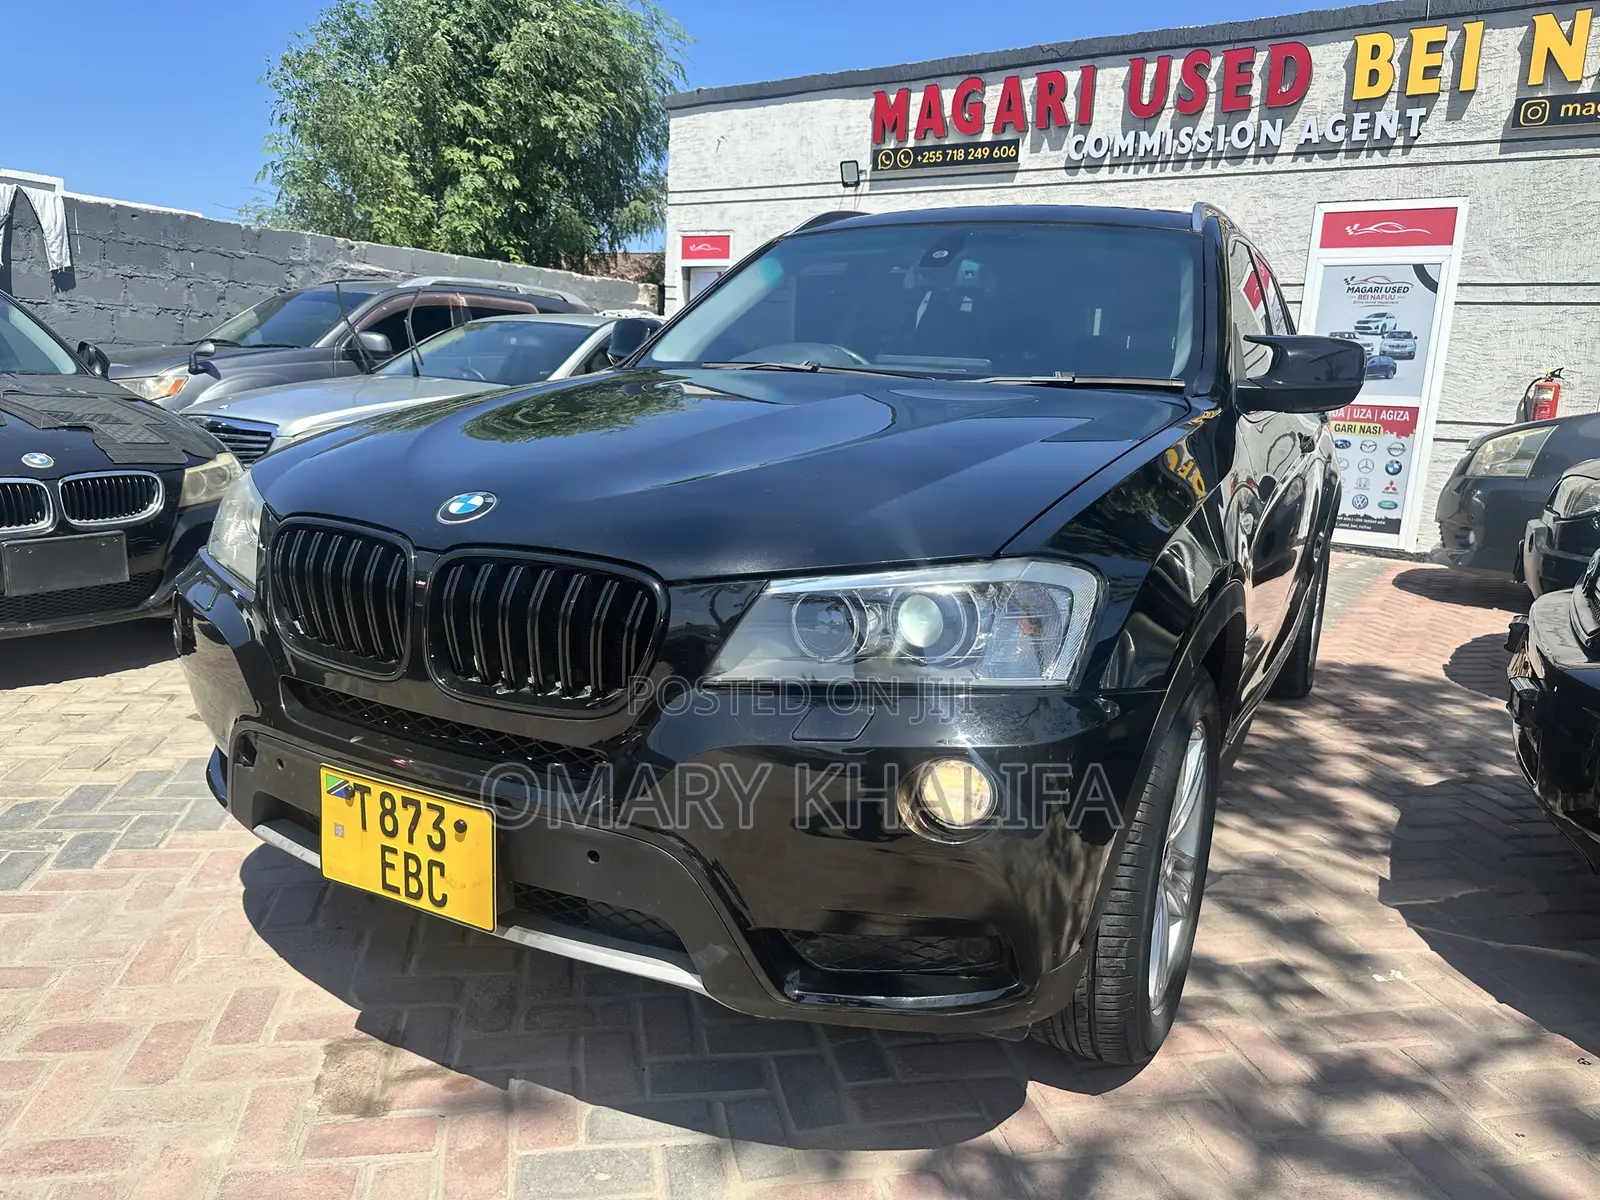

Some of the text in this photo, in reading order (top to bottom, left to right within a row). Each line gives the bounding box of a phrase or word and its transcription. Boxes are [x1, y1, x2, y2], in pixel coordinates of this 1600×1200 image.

[873, 65, 1096, 144] MAGARI
[1128, 41, 1313, 119] USED
[1352, 21, 1485, 100] BEI
[1067, 107, 1427, 160] COMMISSION AGENT
[916, 145, 1016, 163] +255 718 249 606
[1346, 286, 1410, 294] MAGARI USED
[1334, 423, 1382, 435] GARI NASI
[1353, 408, 1372, 419] UZA
[1380, 410, 1410, 422] AGIZA
[353, 782, 447, 852] T 873
[380, 844, 448, 908] EBC
